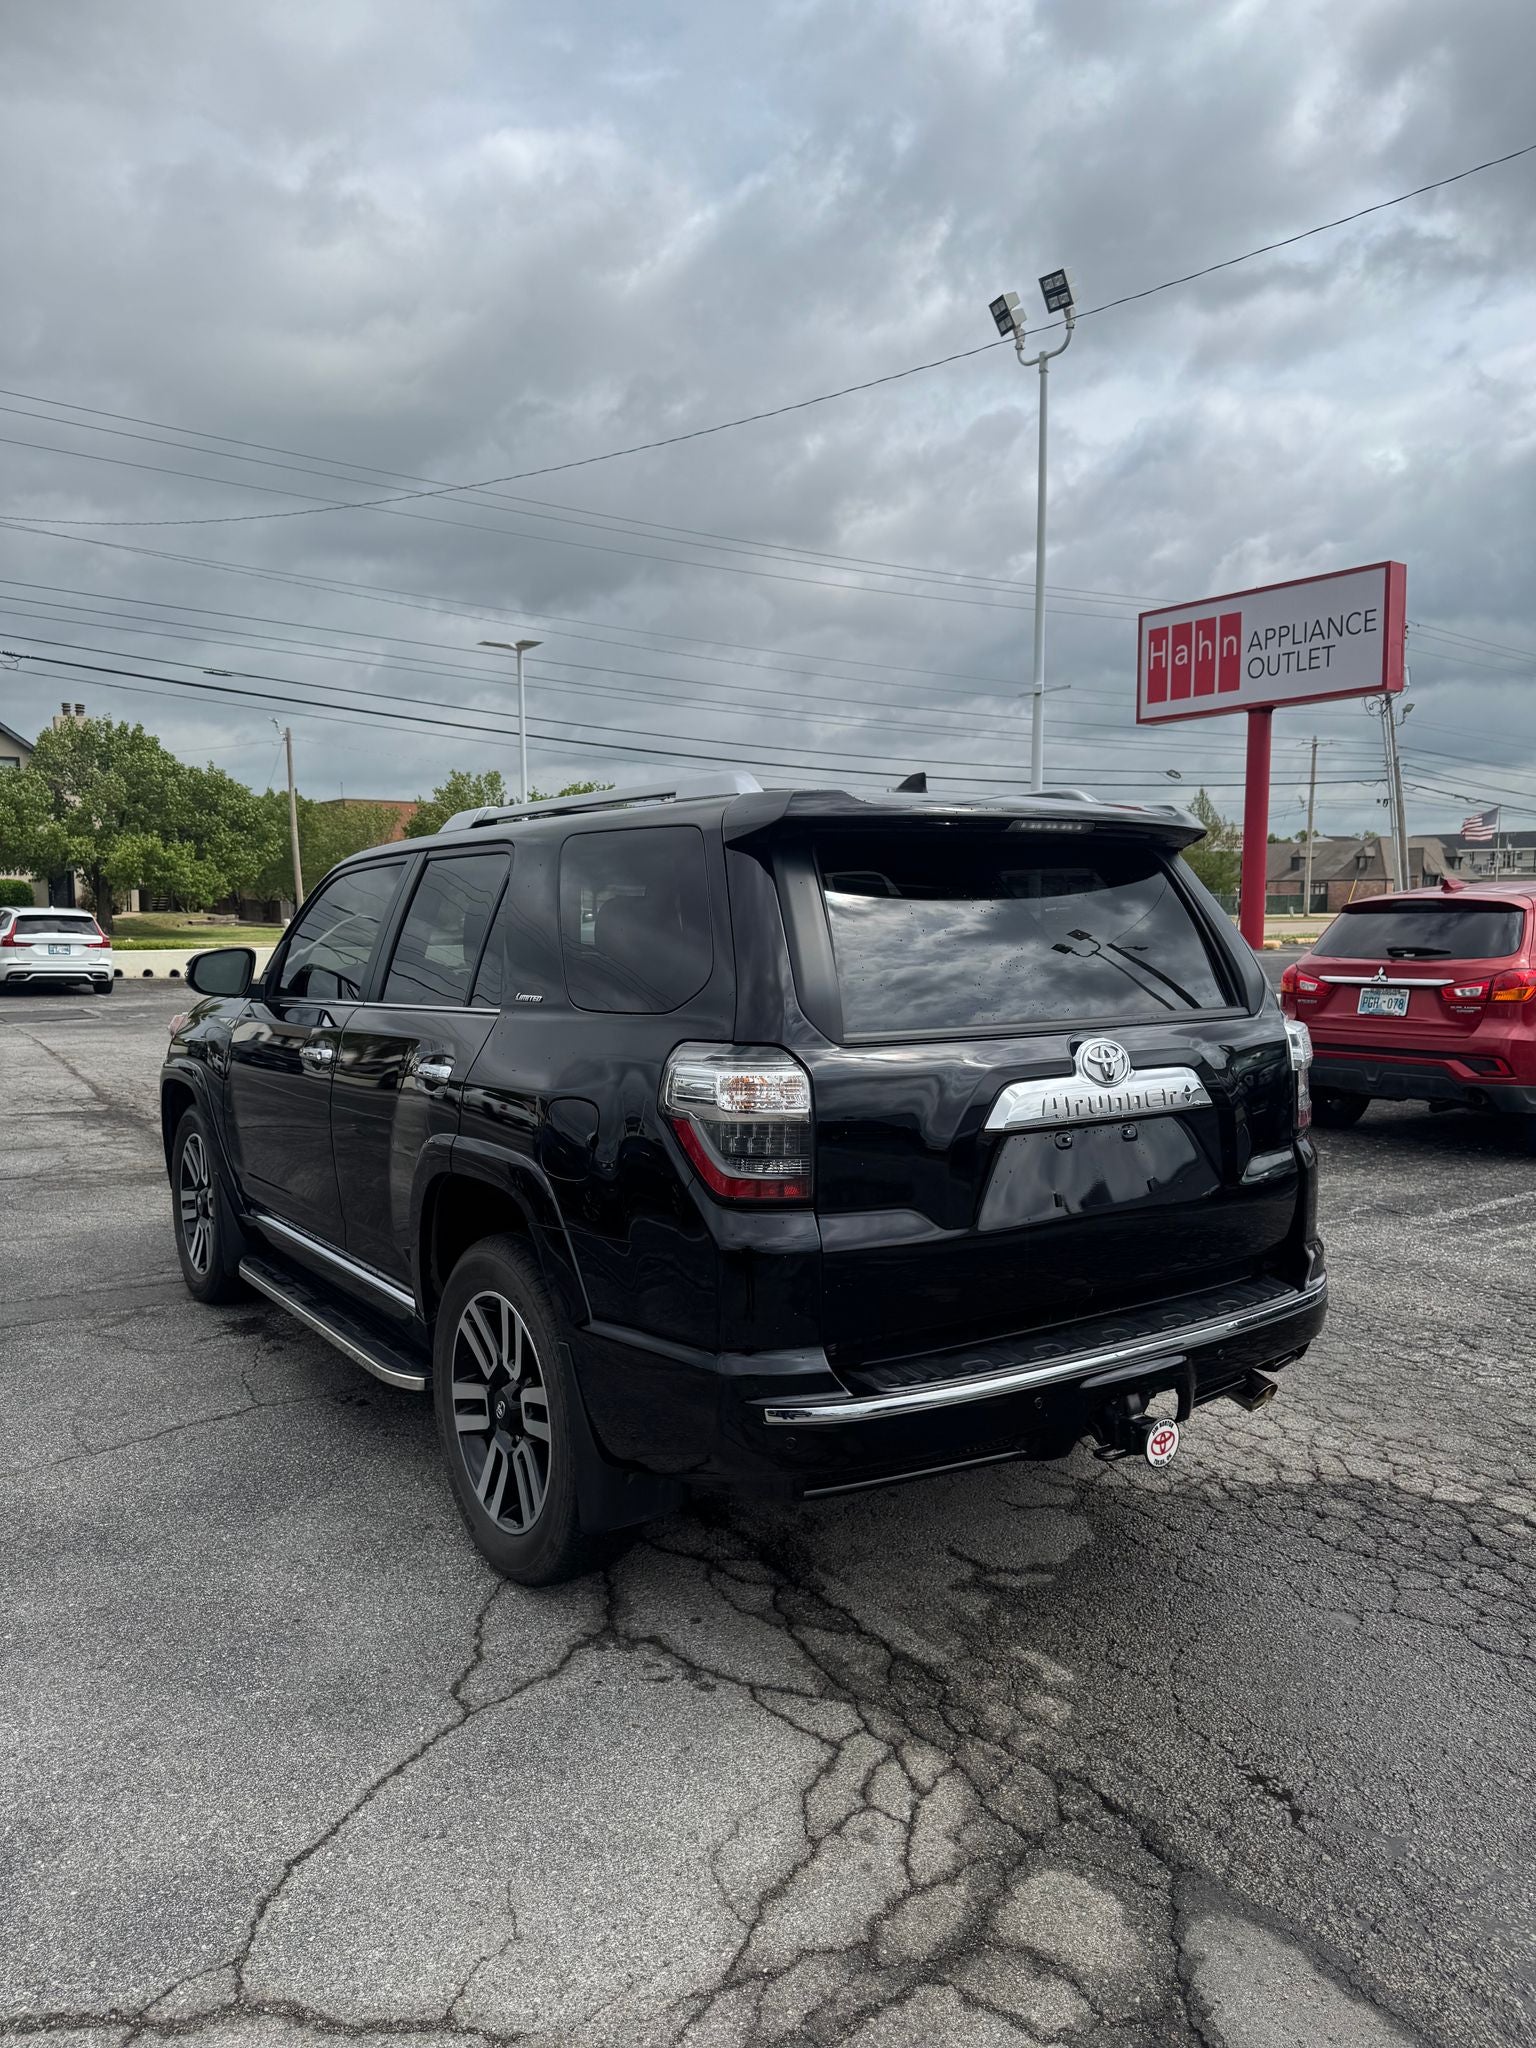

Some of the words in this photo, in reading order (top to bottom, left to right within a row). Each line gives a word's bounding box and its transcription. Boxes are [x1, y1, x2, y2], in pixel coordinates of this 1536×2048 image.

[1150, 630, 1237, 670] Hahn
[1247, 608, 1377, 653] APPLIANCE
[1247, 644, 1336, 679] OUTLET
